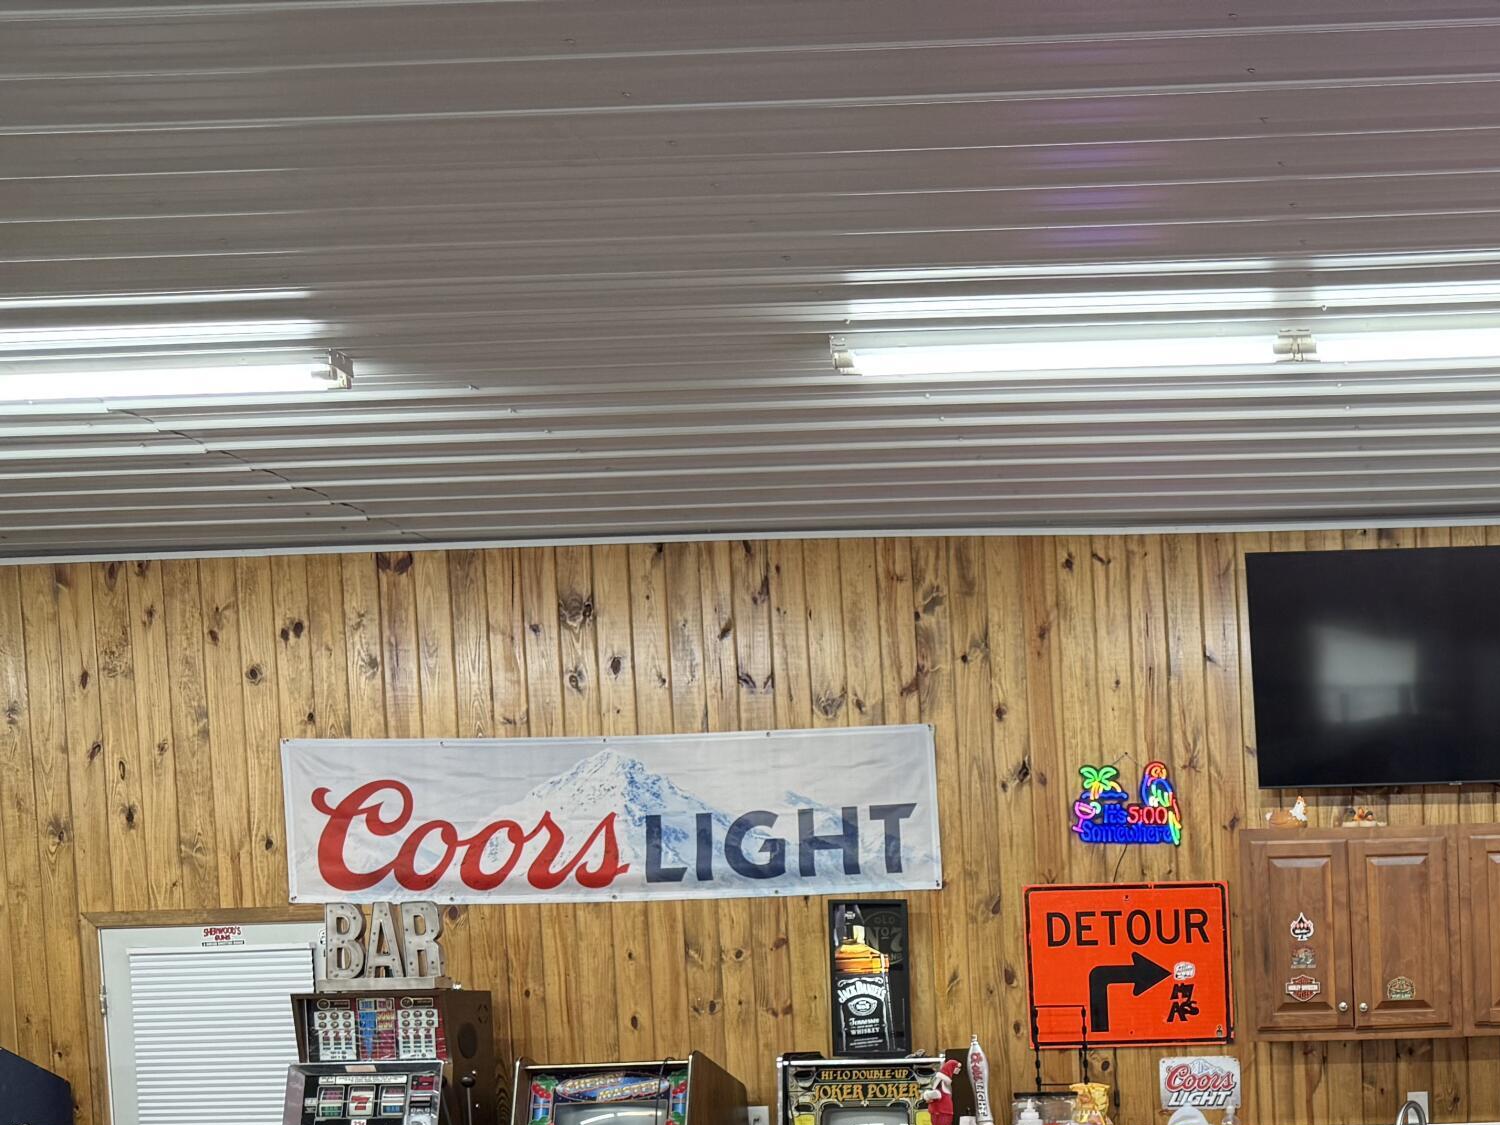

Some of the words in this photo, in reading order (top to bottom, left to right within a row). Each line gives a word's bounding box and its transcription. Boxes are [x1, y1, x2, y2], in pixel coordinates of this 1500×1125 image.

[1127, 805, 1168, 824] 5:00
[311, 779, 631, 892] Coors
[645, 802, 919, 884] LIGHT
[1081, 820, 1172, 842] Somewhere
[1046, 909, 1210, 947] DETOUR
[325, 902, 445, 981] BAR
[838, 983, 857, 1003] JACK
[856, 980, 886, 1000] DANIEL'S
[850, 1027, 880, 1036] WHISKEY
[1166, 1064, 1235, 1092] Coors
[815, 1085, 864, 1100] JOKER
[867, 1084, 922, 1099] POKER
[1168, 1091, 1232, 1107] LIGHT
